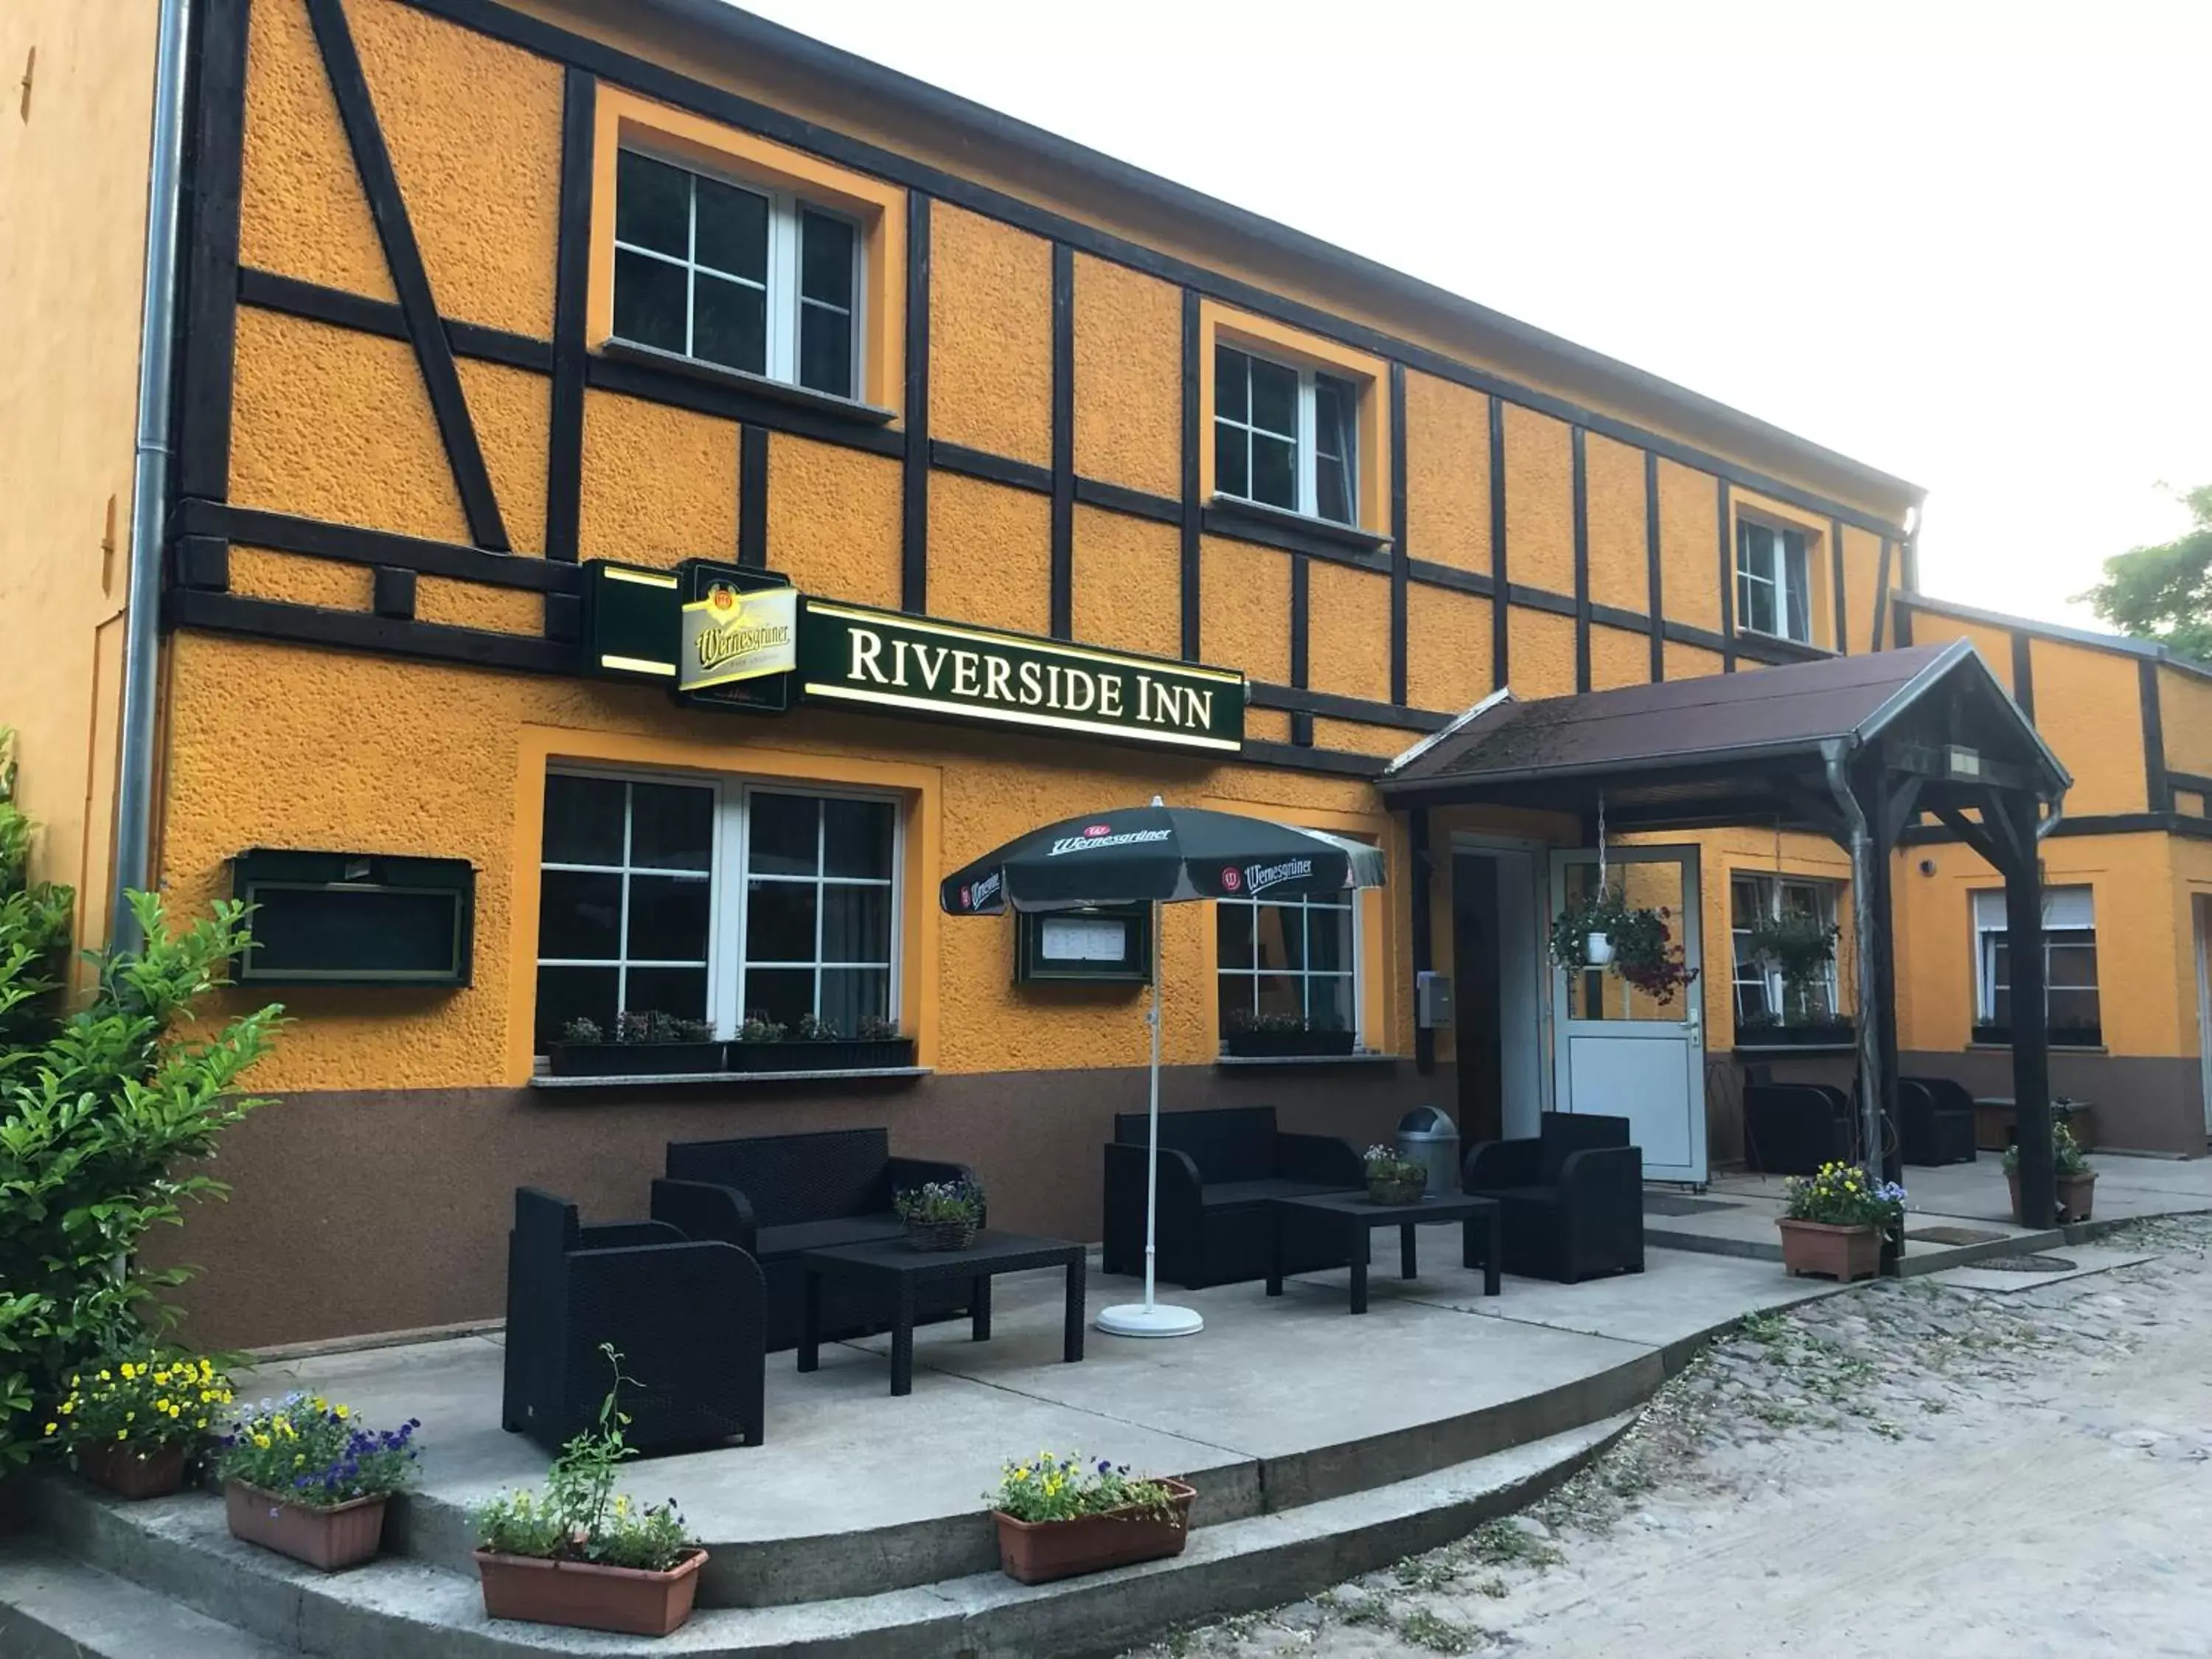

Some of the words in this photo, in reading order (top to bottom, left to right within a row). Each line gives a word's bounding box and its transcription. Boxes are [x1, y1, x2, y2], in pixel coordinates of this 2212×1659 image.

[847, 627, 1123, 717] RIVERSIDE
[1136, 675, 1213, 730] INN
[1048, 830, 1172, 855] Wernesgrüner
[1245, 858, 1312, 894] Wernesgrüner
